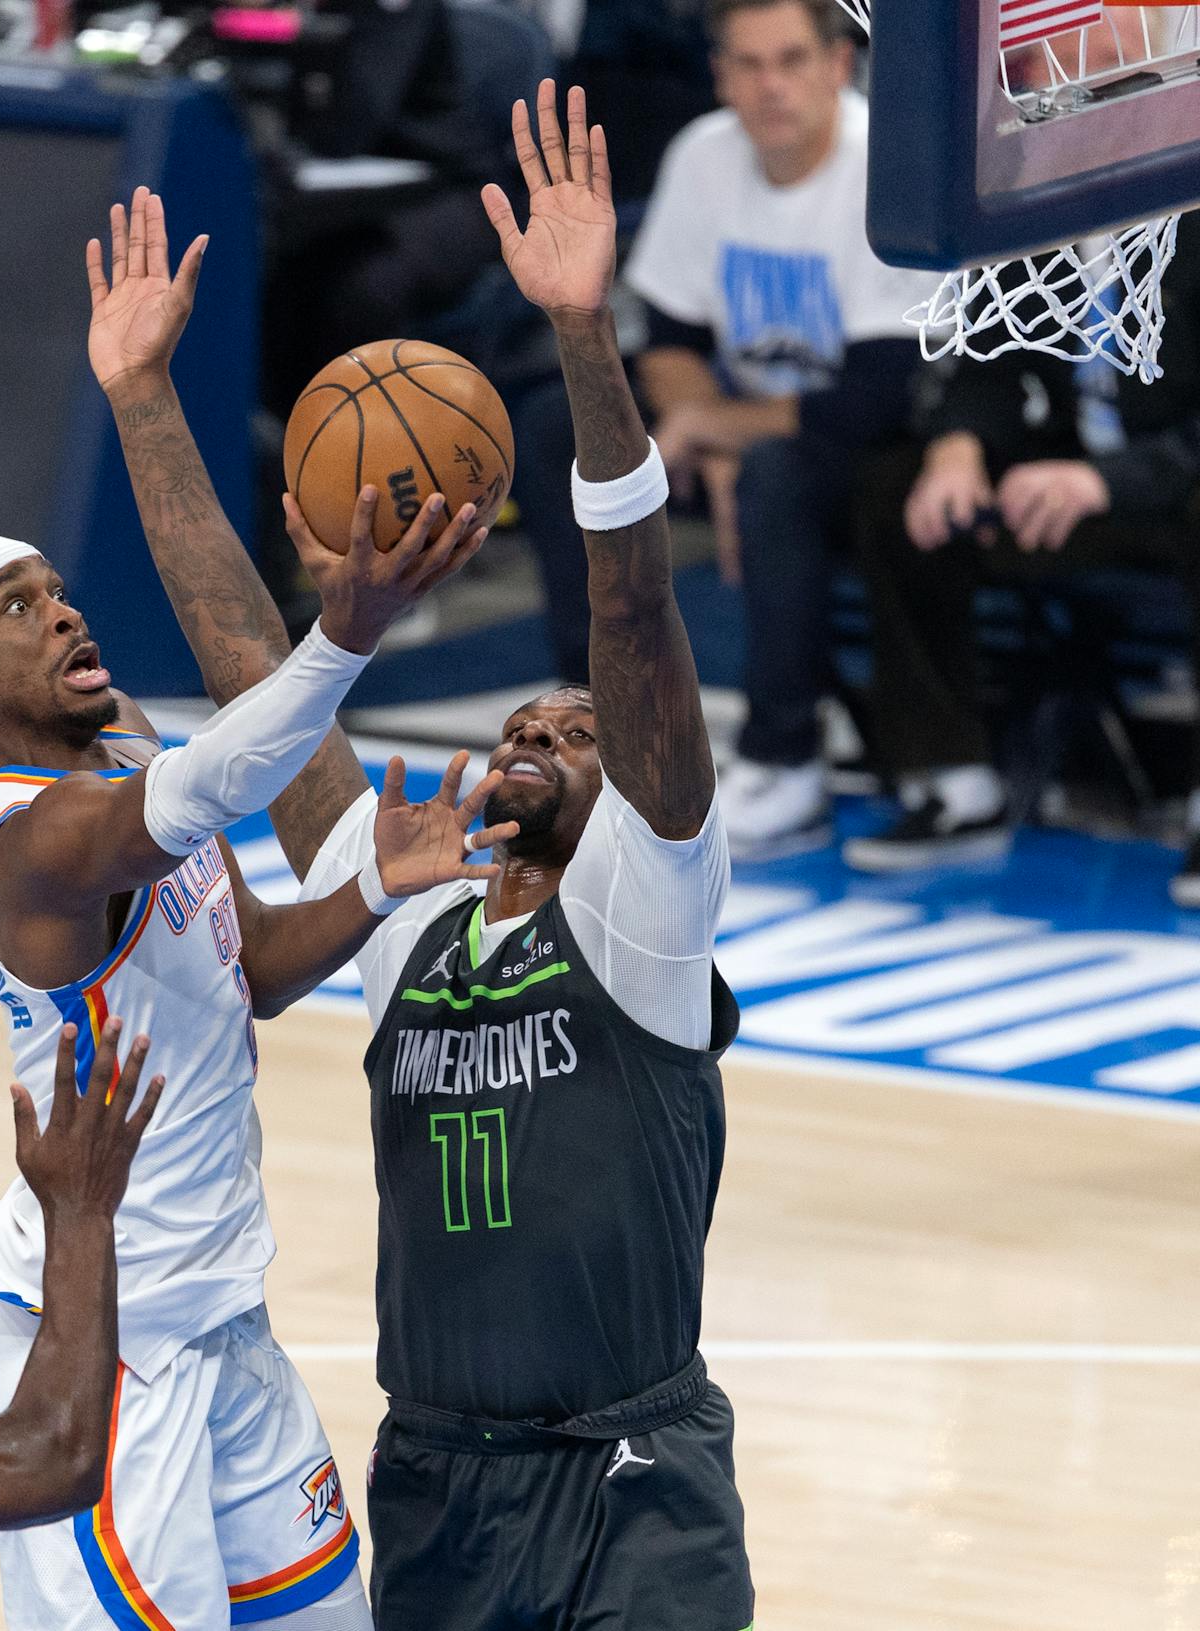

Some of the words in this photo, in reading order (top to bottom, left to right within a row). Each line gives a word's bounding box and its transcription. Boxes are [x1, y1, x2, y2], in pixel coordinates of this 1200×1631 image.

[501, 940, 554, 978] sezzle
[391, 1008, 578, 1106] TIMBERWOLVES
[430, 1108, 512, 1232] 11
